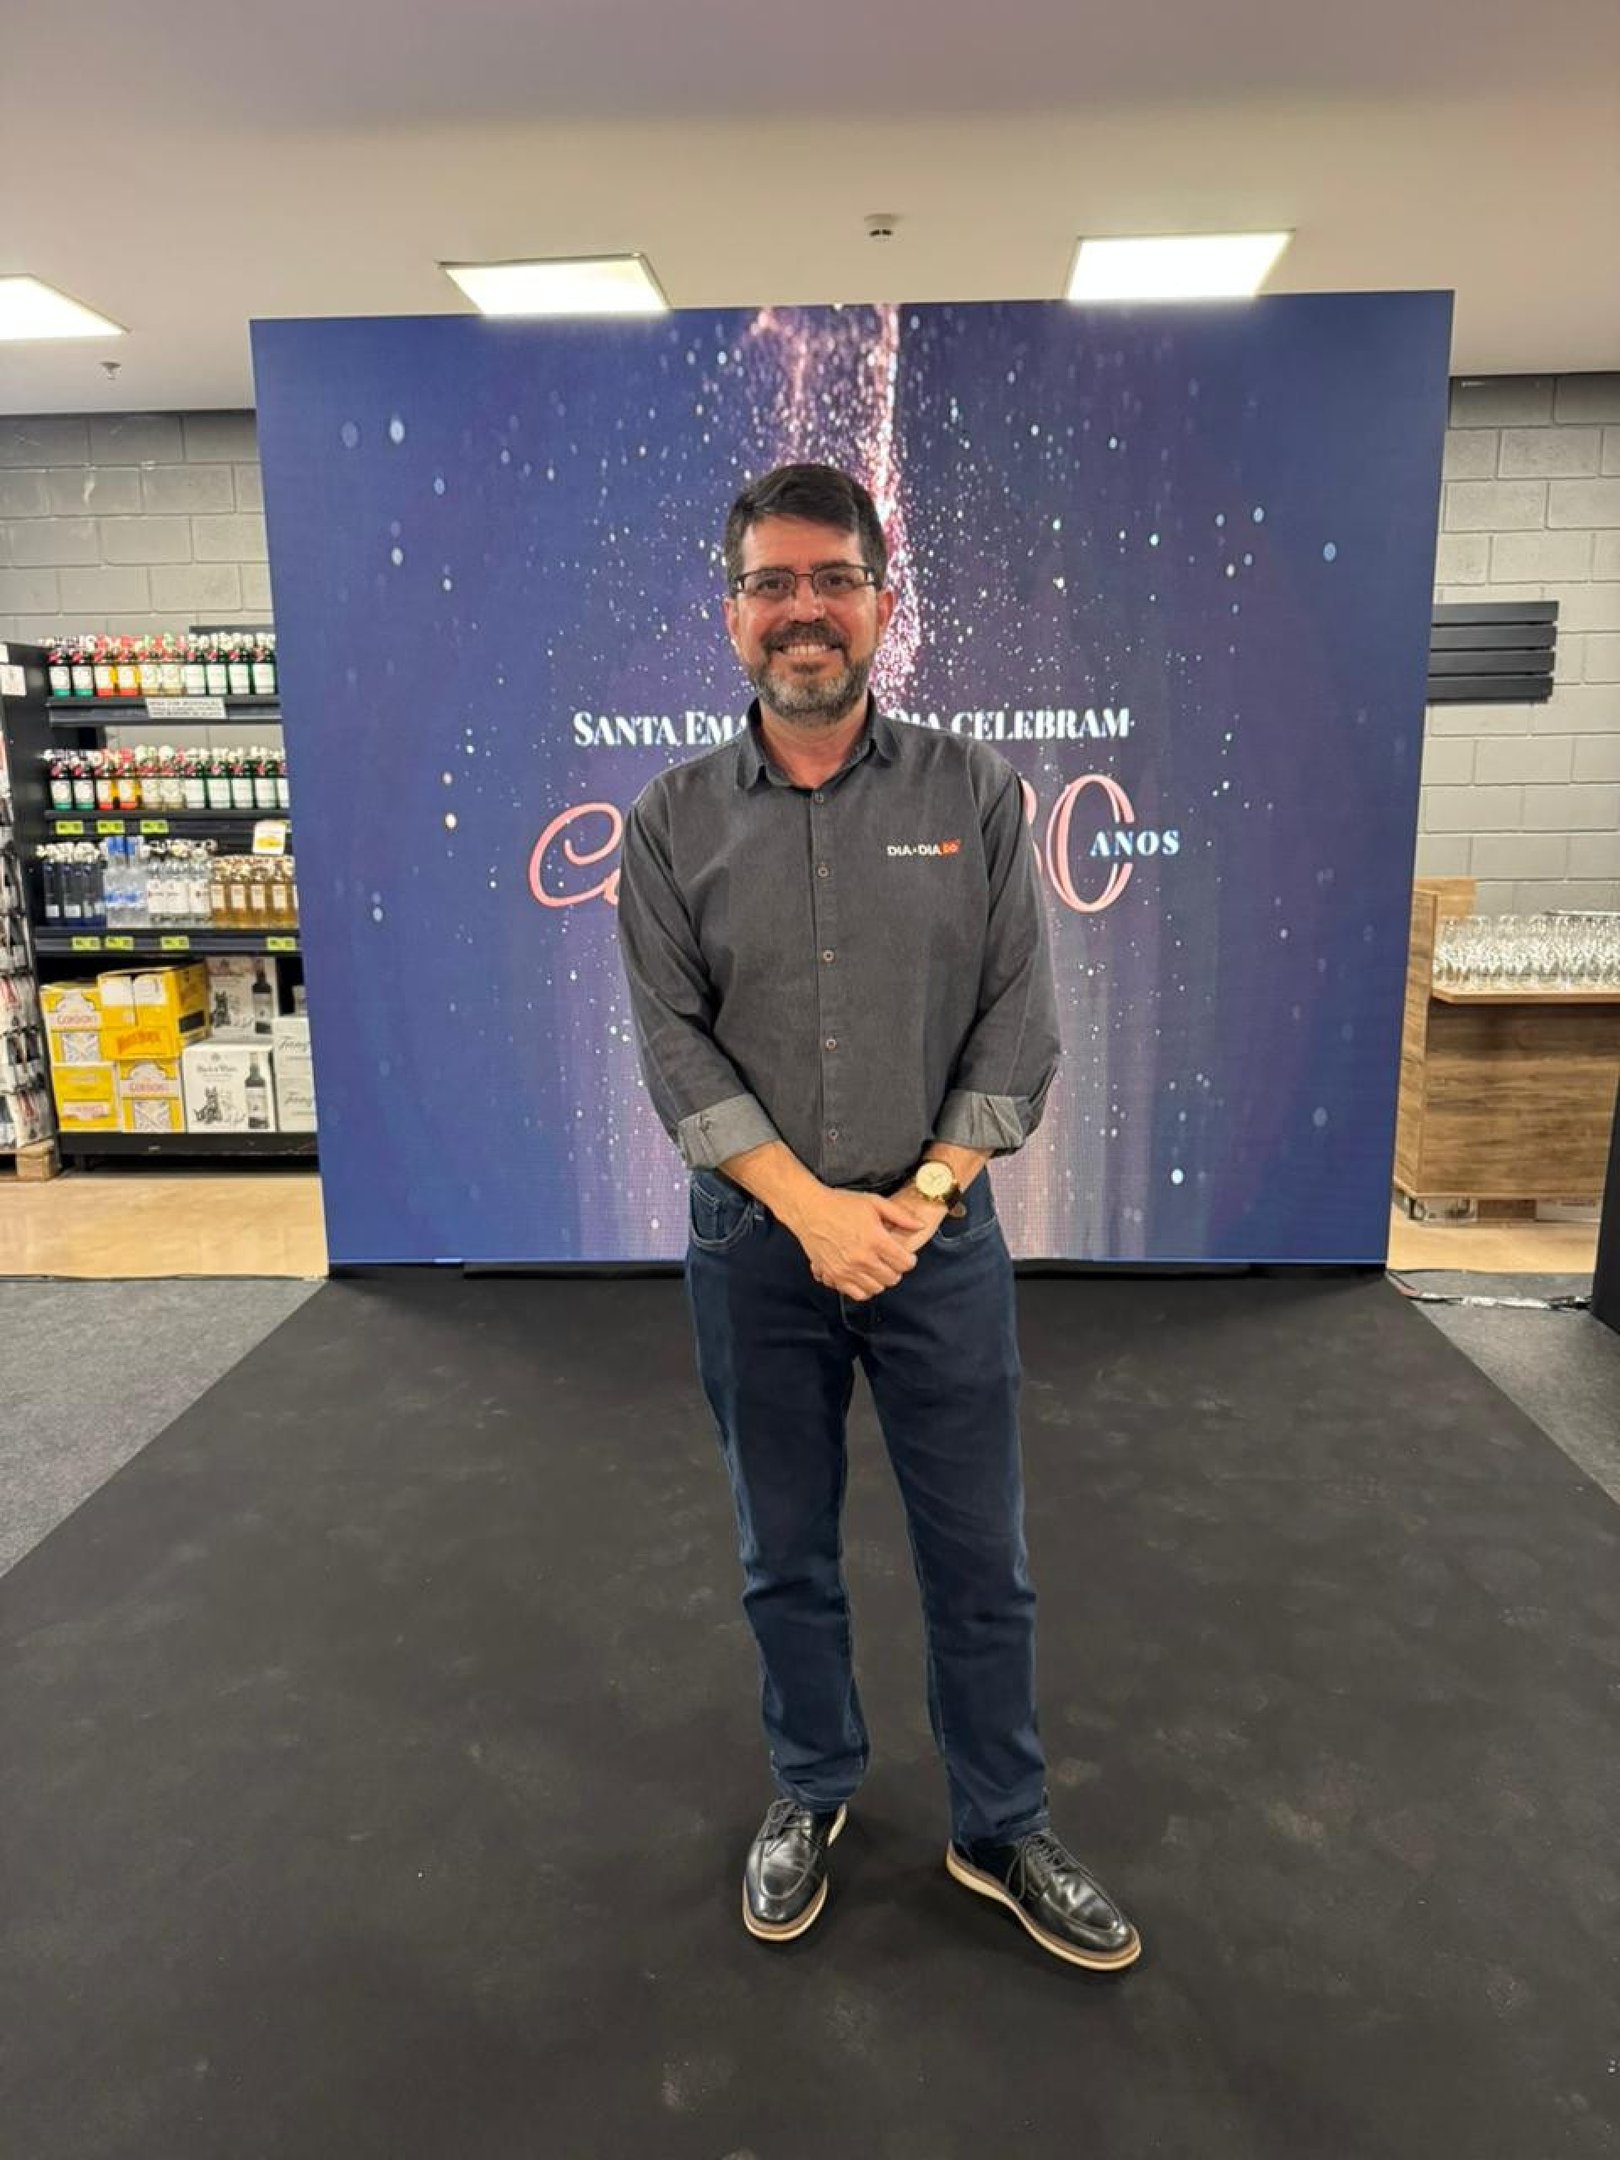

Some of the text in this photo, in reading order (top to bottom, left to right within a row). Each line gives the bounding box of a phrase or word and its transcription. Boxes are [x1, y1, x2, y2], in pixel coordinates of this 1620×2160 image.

[573, 711, 678, 746] SANTA
[685, 710, 747, 745] EM
[950, 708, 1130, 740] CELEBRAM
[1090, 830, 1181, 857] ANOS
